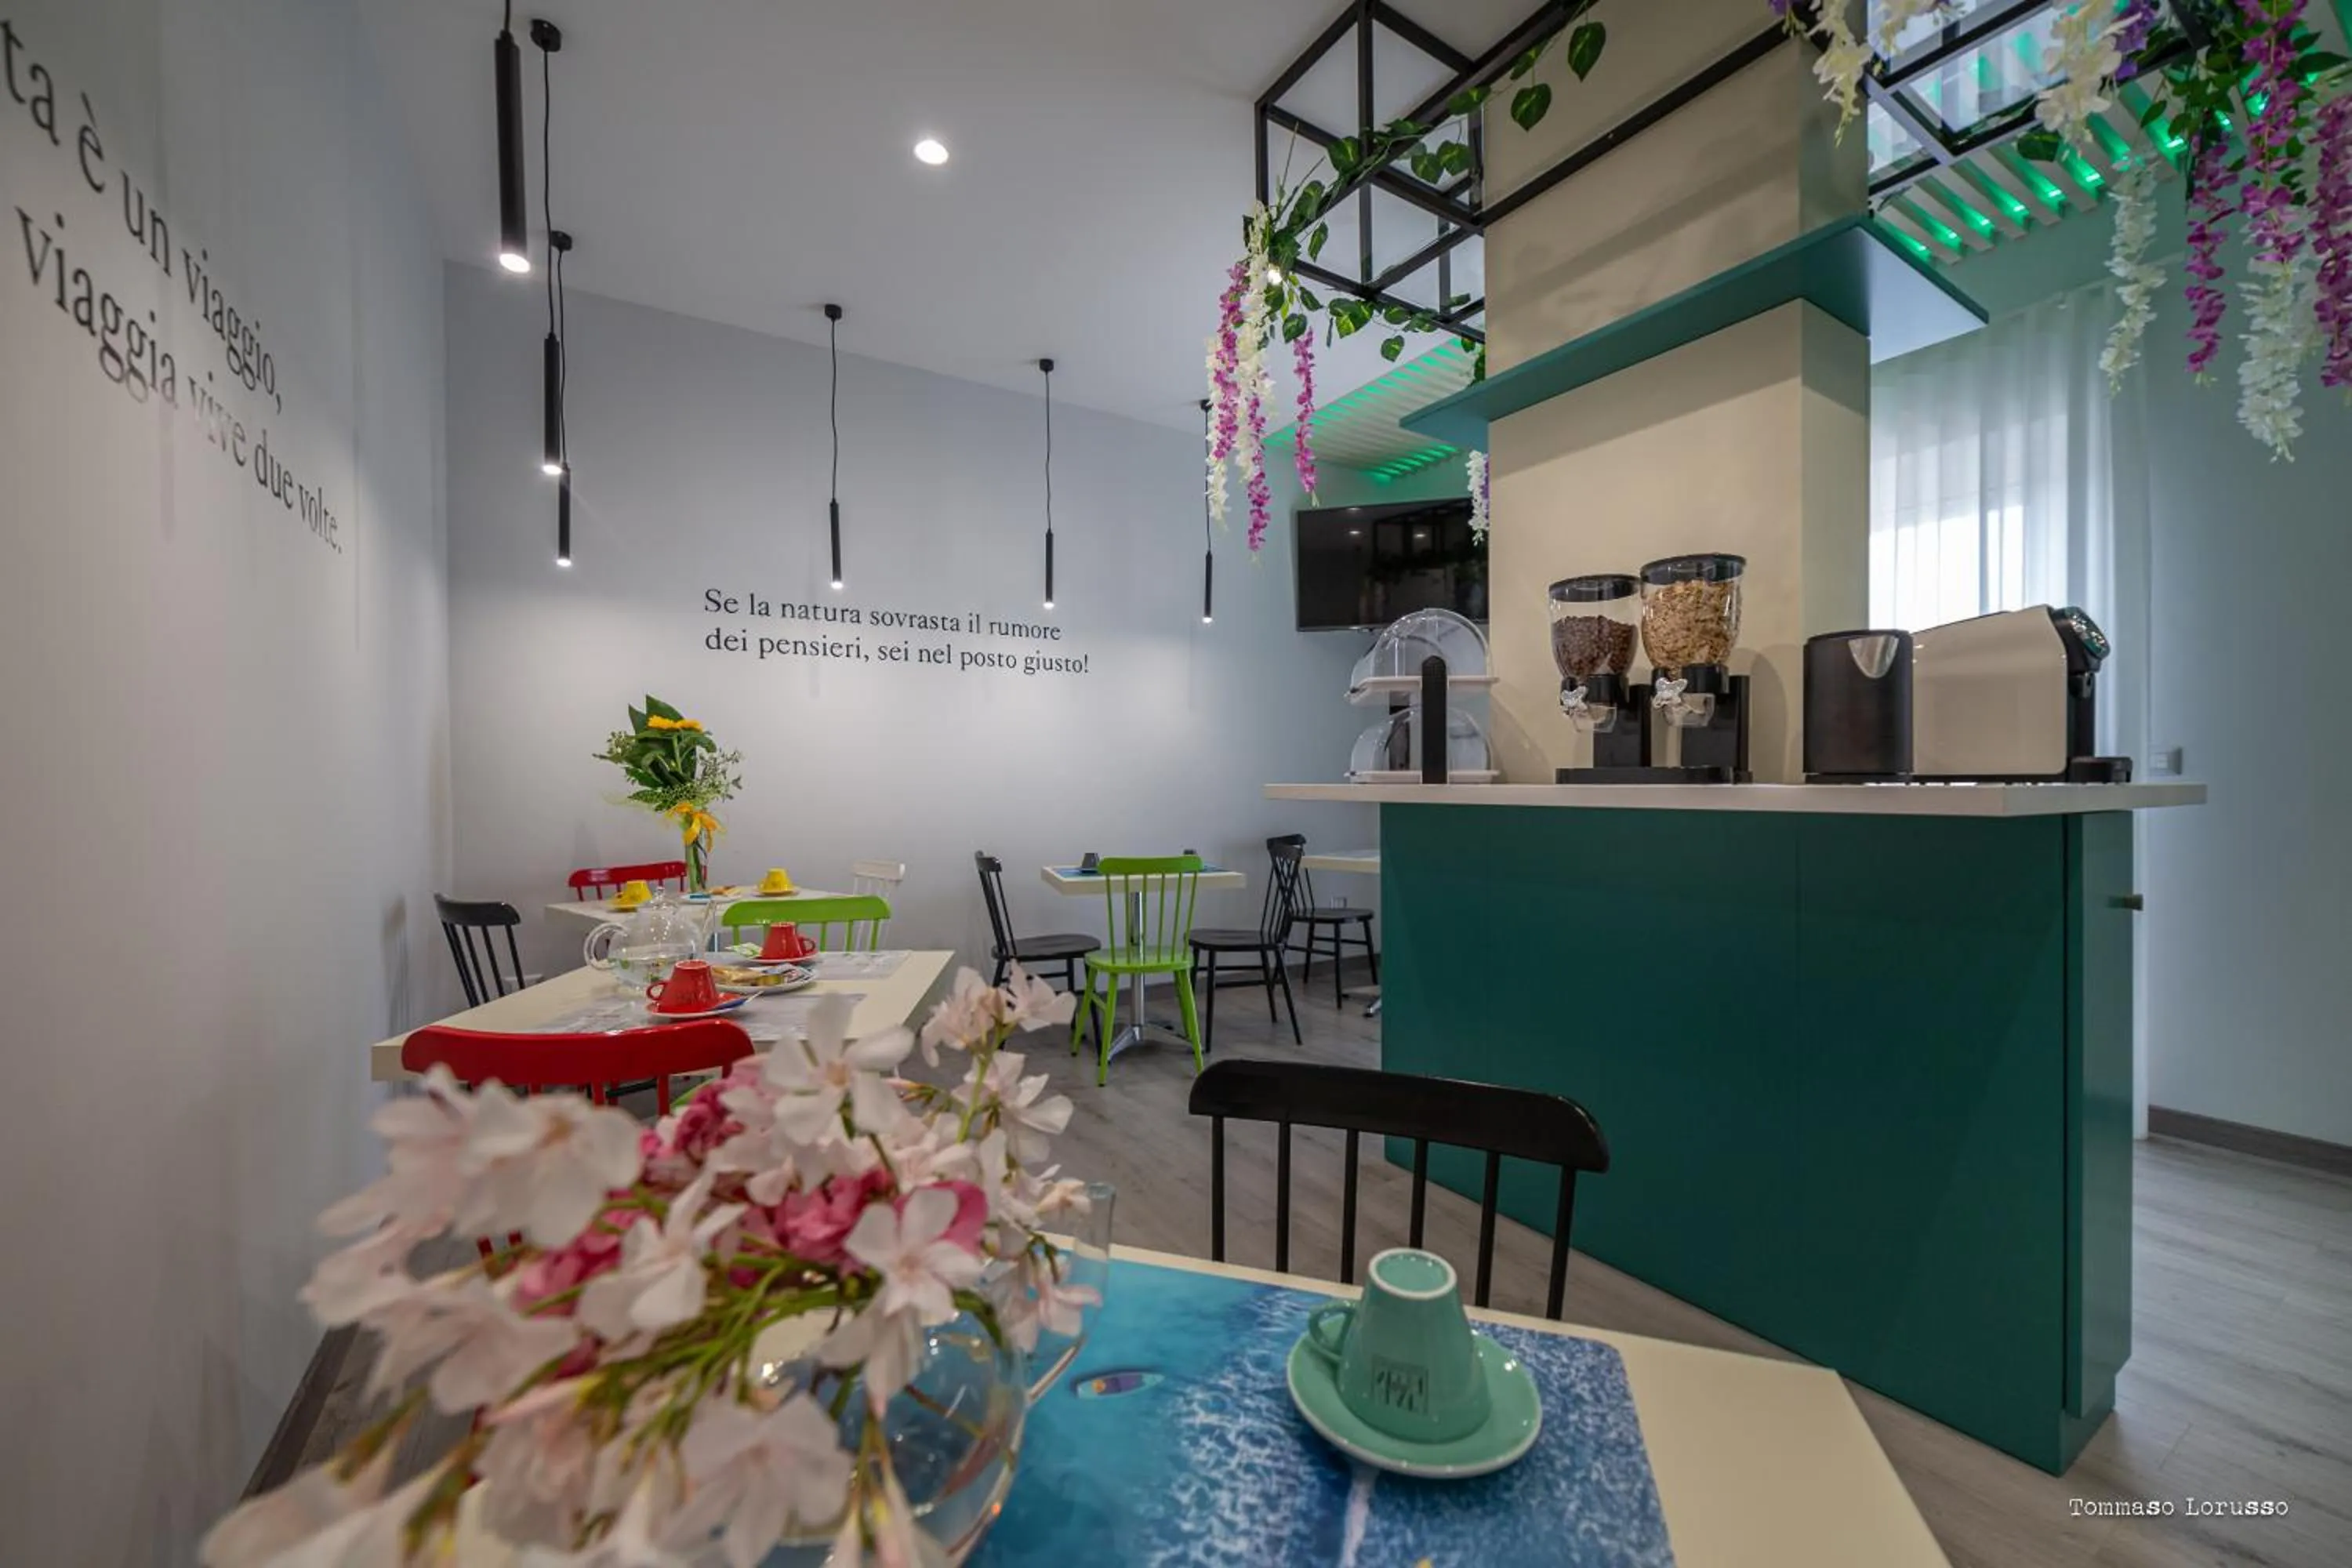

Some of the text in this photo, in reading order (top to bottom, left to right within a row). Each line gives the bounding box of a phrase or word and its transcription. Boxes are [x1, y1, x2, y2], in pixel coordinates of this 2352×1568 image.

[78, 91, 106, 194] è
[120, 169, 172, 278] un
[181, 248, 283, 416] viaggio,
[15, 205, 180, 412] Viaggia
[254, 428, 294, 510] due
[298, 483, 343, 554] volte.
[704, 588, 1062, 641] Se la natura sovrasta il rumore
[705, 627, 1091, 676] dei pensieri, sei nel posto giusto!
